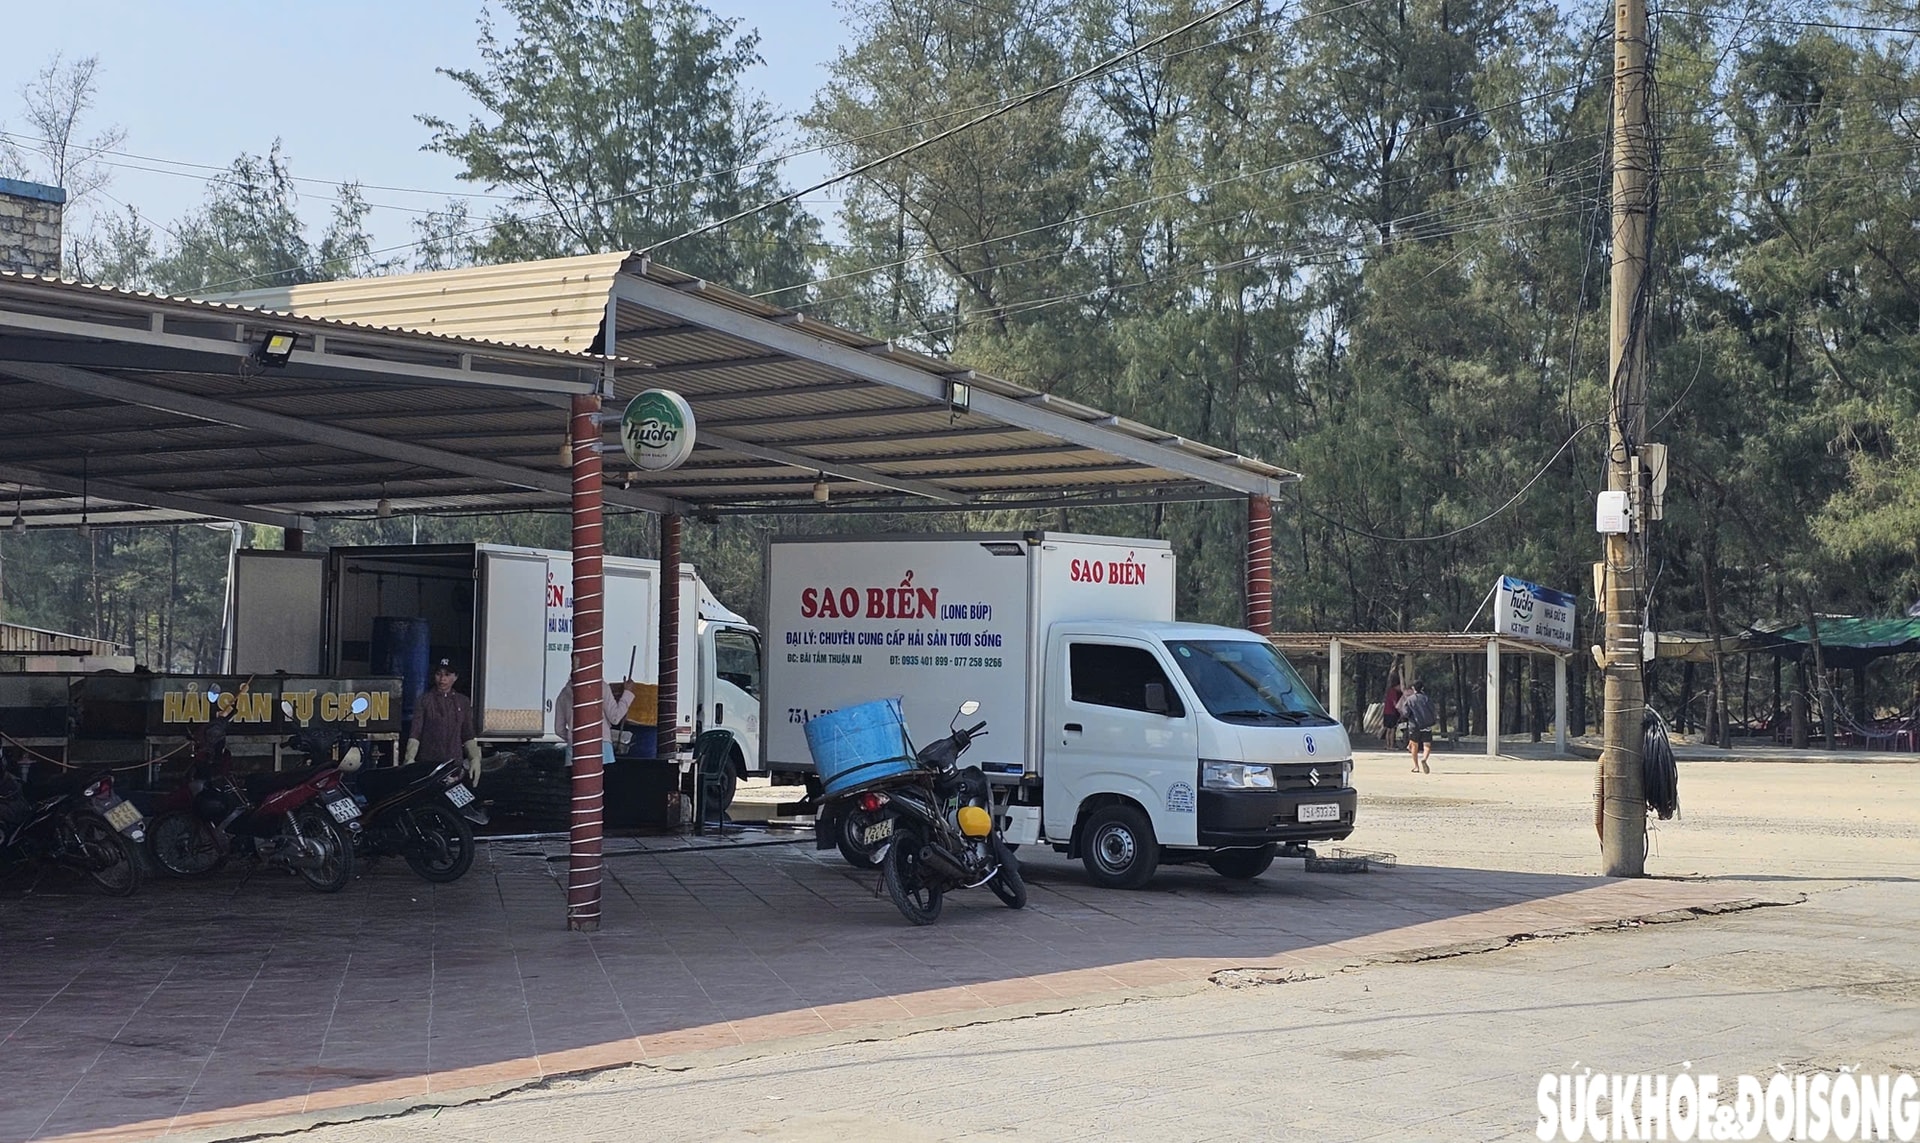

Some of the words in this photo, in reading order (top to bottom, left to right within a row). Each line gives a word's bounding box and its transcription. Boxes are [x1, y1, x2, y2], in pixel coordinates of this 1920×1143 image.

[627, 418, 678, 442] huda
[1070, 559, 1104, 584] SAO
[1108, 551, 1146, 585] BIỂN
[801, 587, 859, 618] SAO
[865, 569, 939, 619] BIỂN
[941, 604, 968, 621] (LONG
[970, 602, 992, 621] BÚP)
[786, 631, 801, 647] ĐẠI
[804, 629, 817, 645] LÝ:
[819, 630, 855, 645] CHUYÊN
[858, 632, 883, 645] CUNG
[886, 628, 905, 646] CẤP
[908, 629, 924, 646] HẢI
[927, 629, 947, 646] SẢN
[950, 632, 971, 646] TƯƠI
[974, 630, 1002, 647] SỐNG
[852, 655, 862, 664] AN
[920, 655, 933, 666] 401
[954, 657, 967, 667] 077
[163, 682, 210, 722] HẢI
